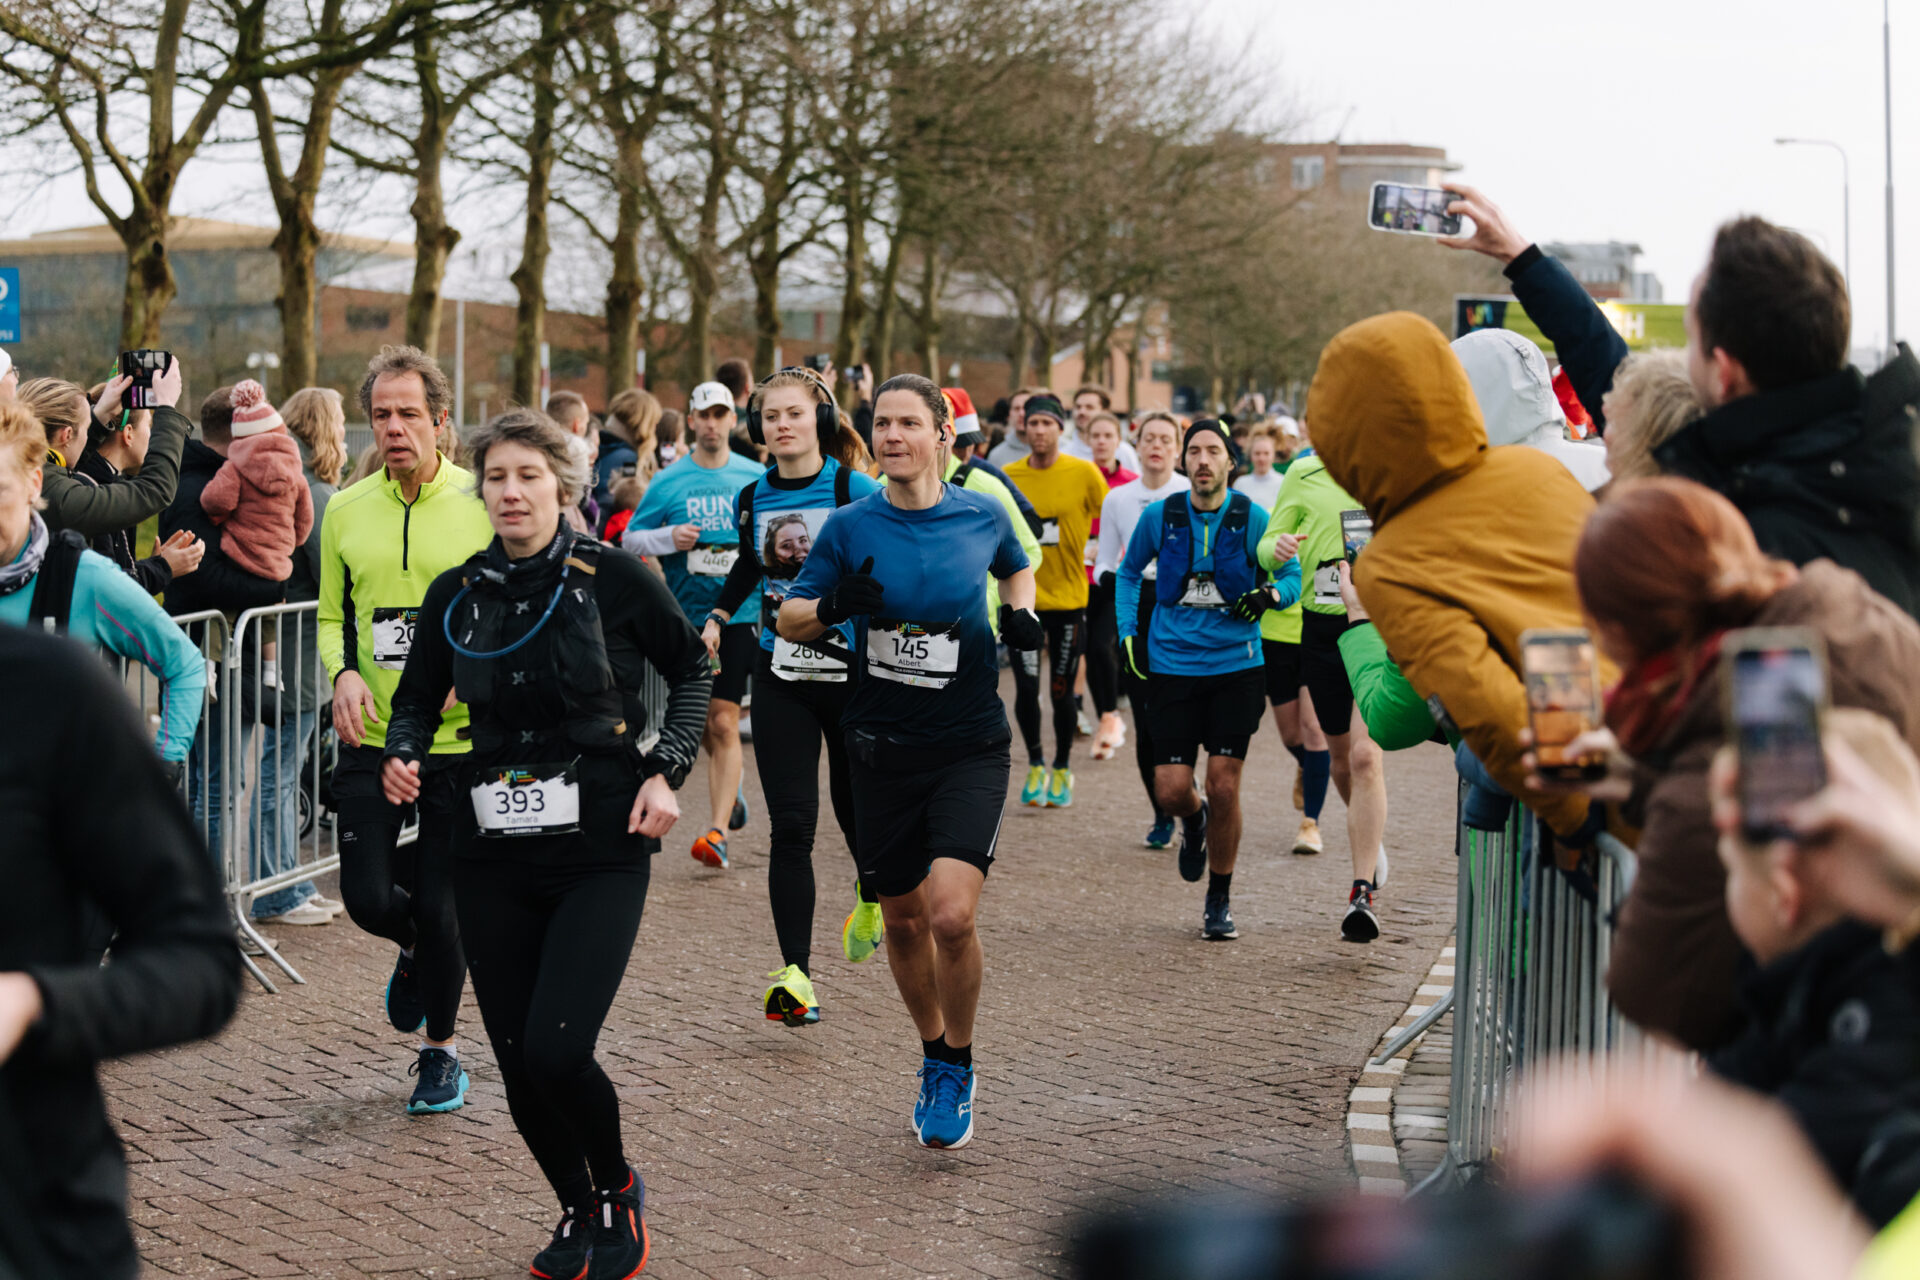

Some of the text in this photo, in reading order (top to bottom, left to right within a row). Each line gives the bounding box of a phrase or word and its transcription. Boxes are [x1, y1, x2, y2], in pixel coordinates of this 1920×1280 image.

[687, 487, 732, 497] ABSOLUTE
[686, 496, 734, 518] RUN
[703, 555, 729, 567] 446
[891, 638, 929, 660] 145
[898, 659, 921, 668] Albert
[495, 789, 545, 815] 393
[505, 816, 539, 825] Tamara
